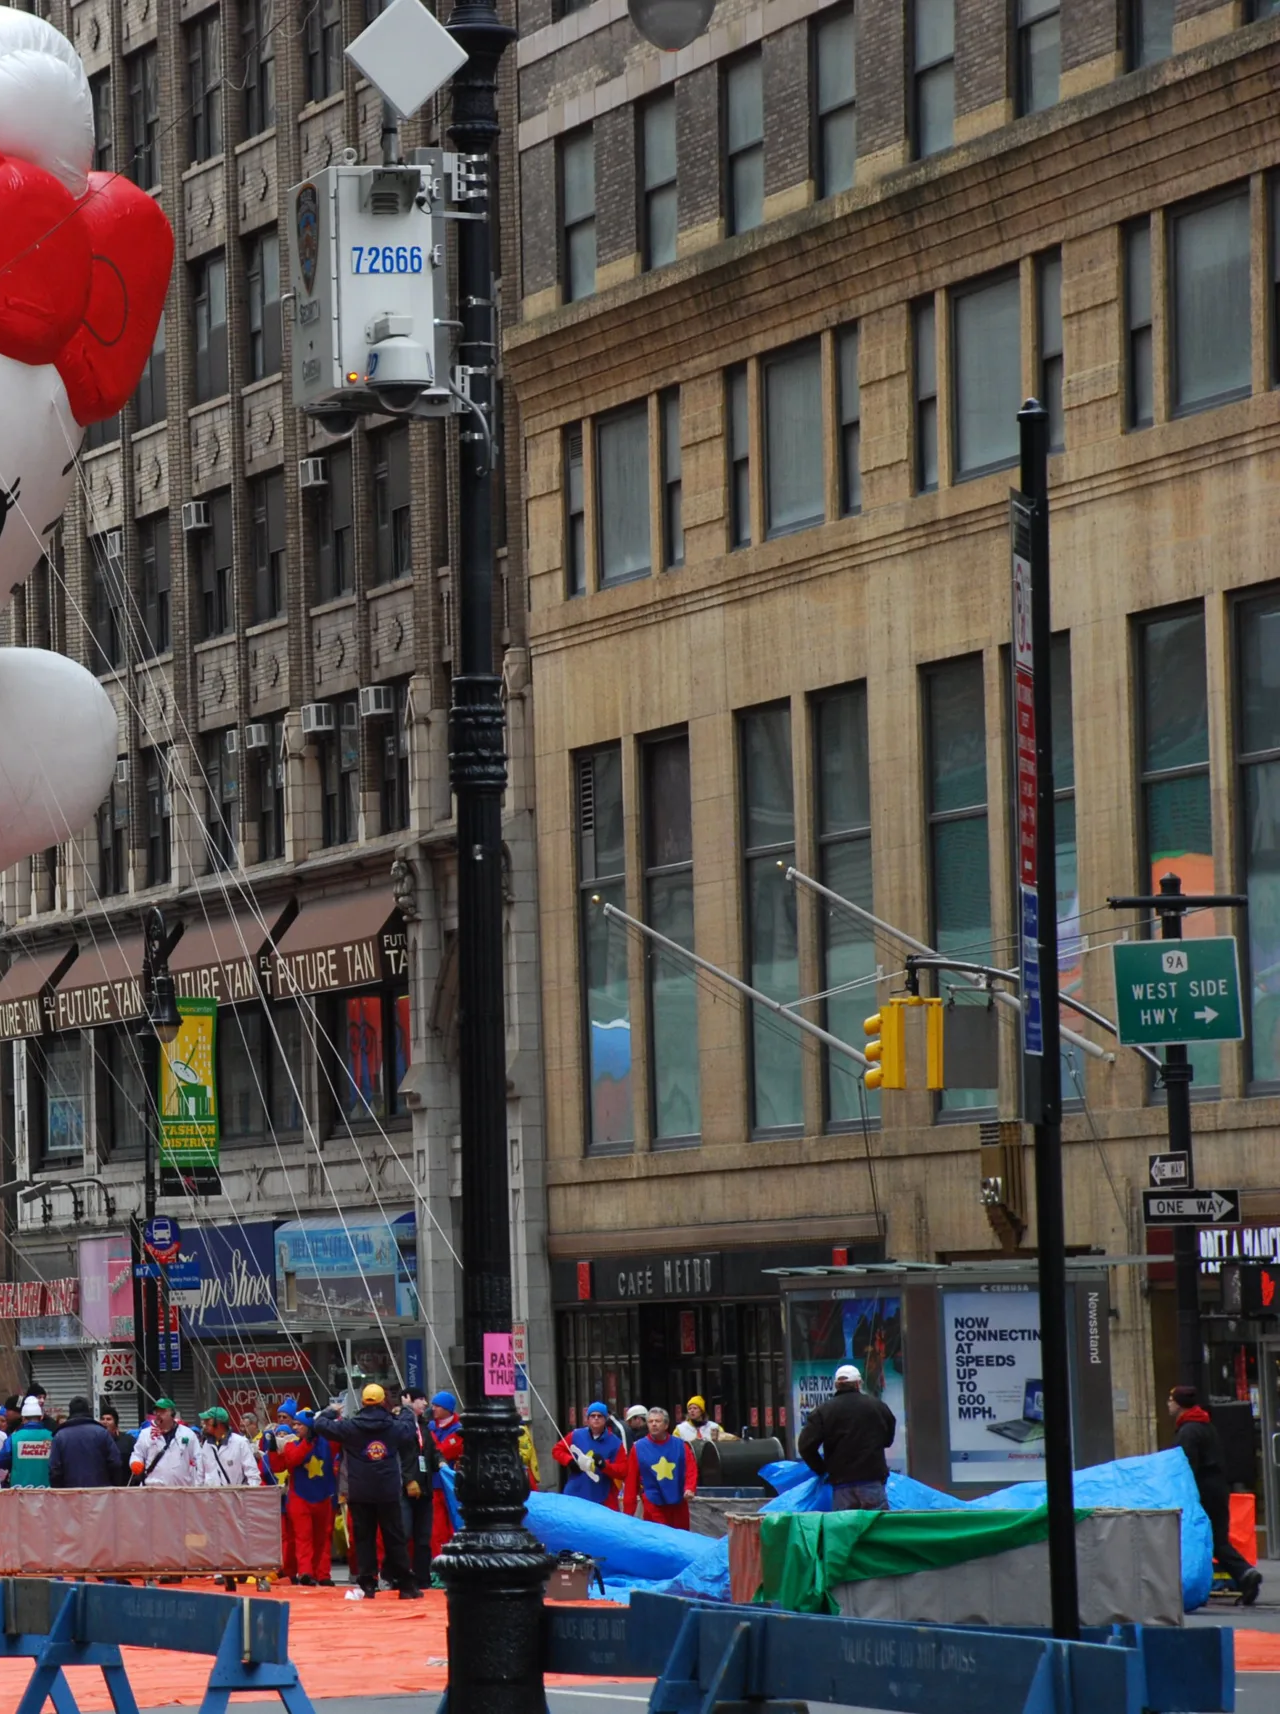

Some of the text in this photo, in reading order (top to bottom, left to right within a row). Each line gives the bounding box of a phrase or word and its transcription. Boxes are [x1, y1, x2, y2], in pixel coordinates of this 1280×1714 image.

[352, 246, 423, 273] 7-2666
[276, 949, 339, 995] FUTURE
[343, 941, 376, 983] TAN
[1166, 956, 1184, 969] 9A
[225, 961, 255, 998] TAN
[1132, 979, 1228, 1000] WEST SIDE
[58, 986, 111, 1027] FUTURE
[115, 980, 142, 1016] TAN
[22, 999, 42, 1032] TAN
[1141, 1008, 1178, 1025] HWY
[162, 1124, 216, 1135] FASHION
[162, 1137, 216, 1148] DISTRICT
[1154, 1161, 1183, 1177] ONE WAY
[1157, 1200, 1225, 1214] ONE WAY
[135, 1266, 150, 1276] M7
[224, 1249, 271, 1307] Shoes
[617, 1258, 712, 1296] CAFÉ METRO
[954, 1317, 990, 1329] NOW
[1088, 1292, 1101, 1364] Newsstand
[955, 1343, 974, 1354] AT
[102, 1354, 134, 1365] ANY
[224, 1352, 302, 1370] JCPenney
[956, 1355, 1016, 1367] SPEEDS
[103, 1366, 134, 1377] BAG
[956, 1368, 978, 1380] UP
[104, 1380, 134, 1392] $20
[799, 1376, 834, 1392] OVER 700
[957, 1381, 977, 1393] TO
[227, 1389, 301, 1405] JCPenney
[958, 1394, 985, 1405] 600
[958, 1407, 997, 1420] MPH.
